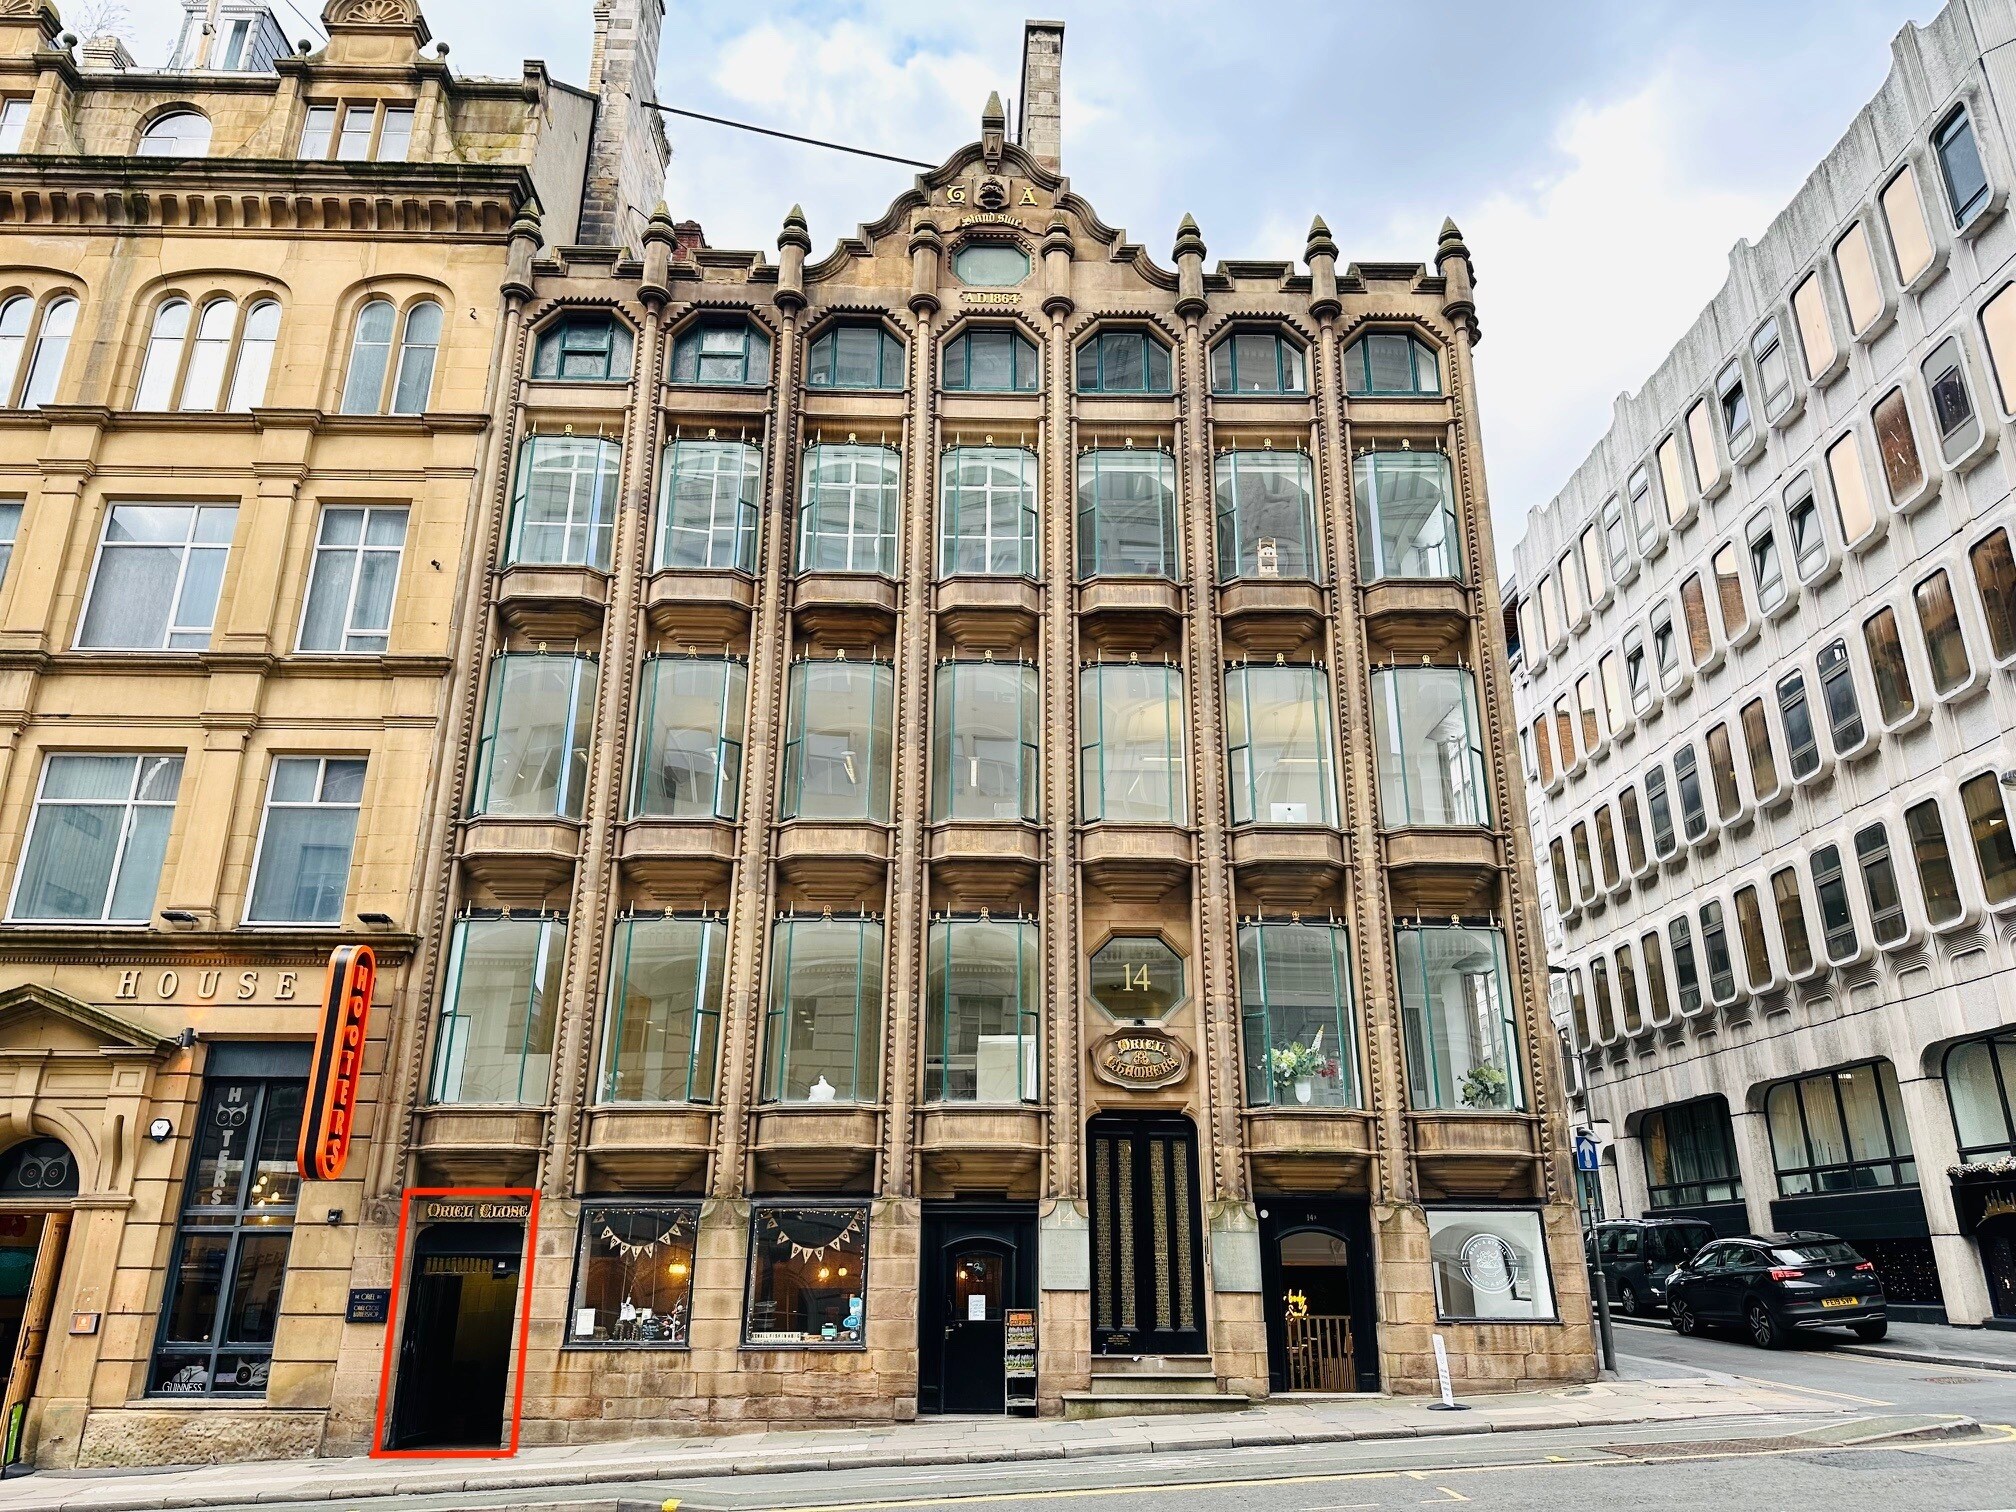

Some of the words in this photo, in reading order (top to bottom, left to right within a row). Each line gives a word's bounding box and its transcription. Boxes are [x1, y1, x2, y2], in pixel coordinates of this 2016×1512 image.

[1018, 186, 1038, 206] A
[115, 970, 298, 999] HOUSE
[1122, 962, 1151, 991] 14
[327, 964, 369, 1165] HOOTERS
[1057, 1209, 1075, 1227] 14
[162, 1381, 203, 1392] GUINNESS
